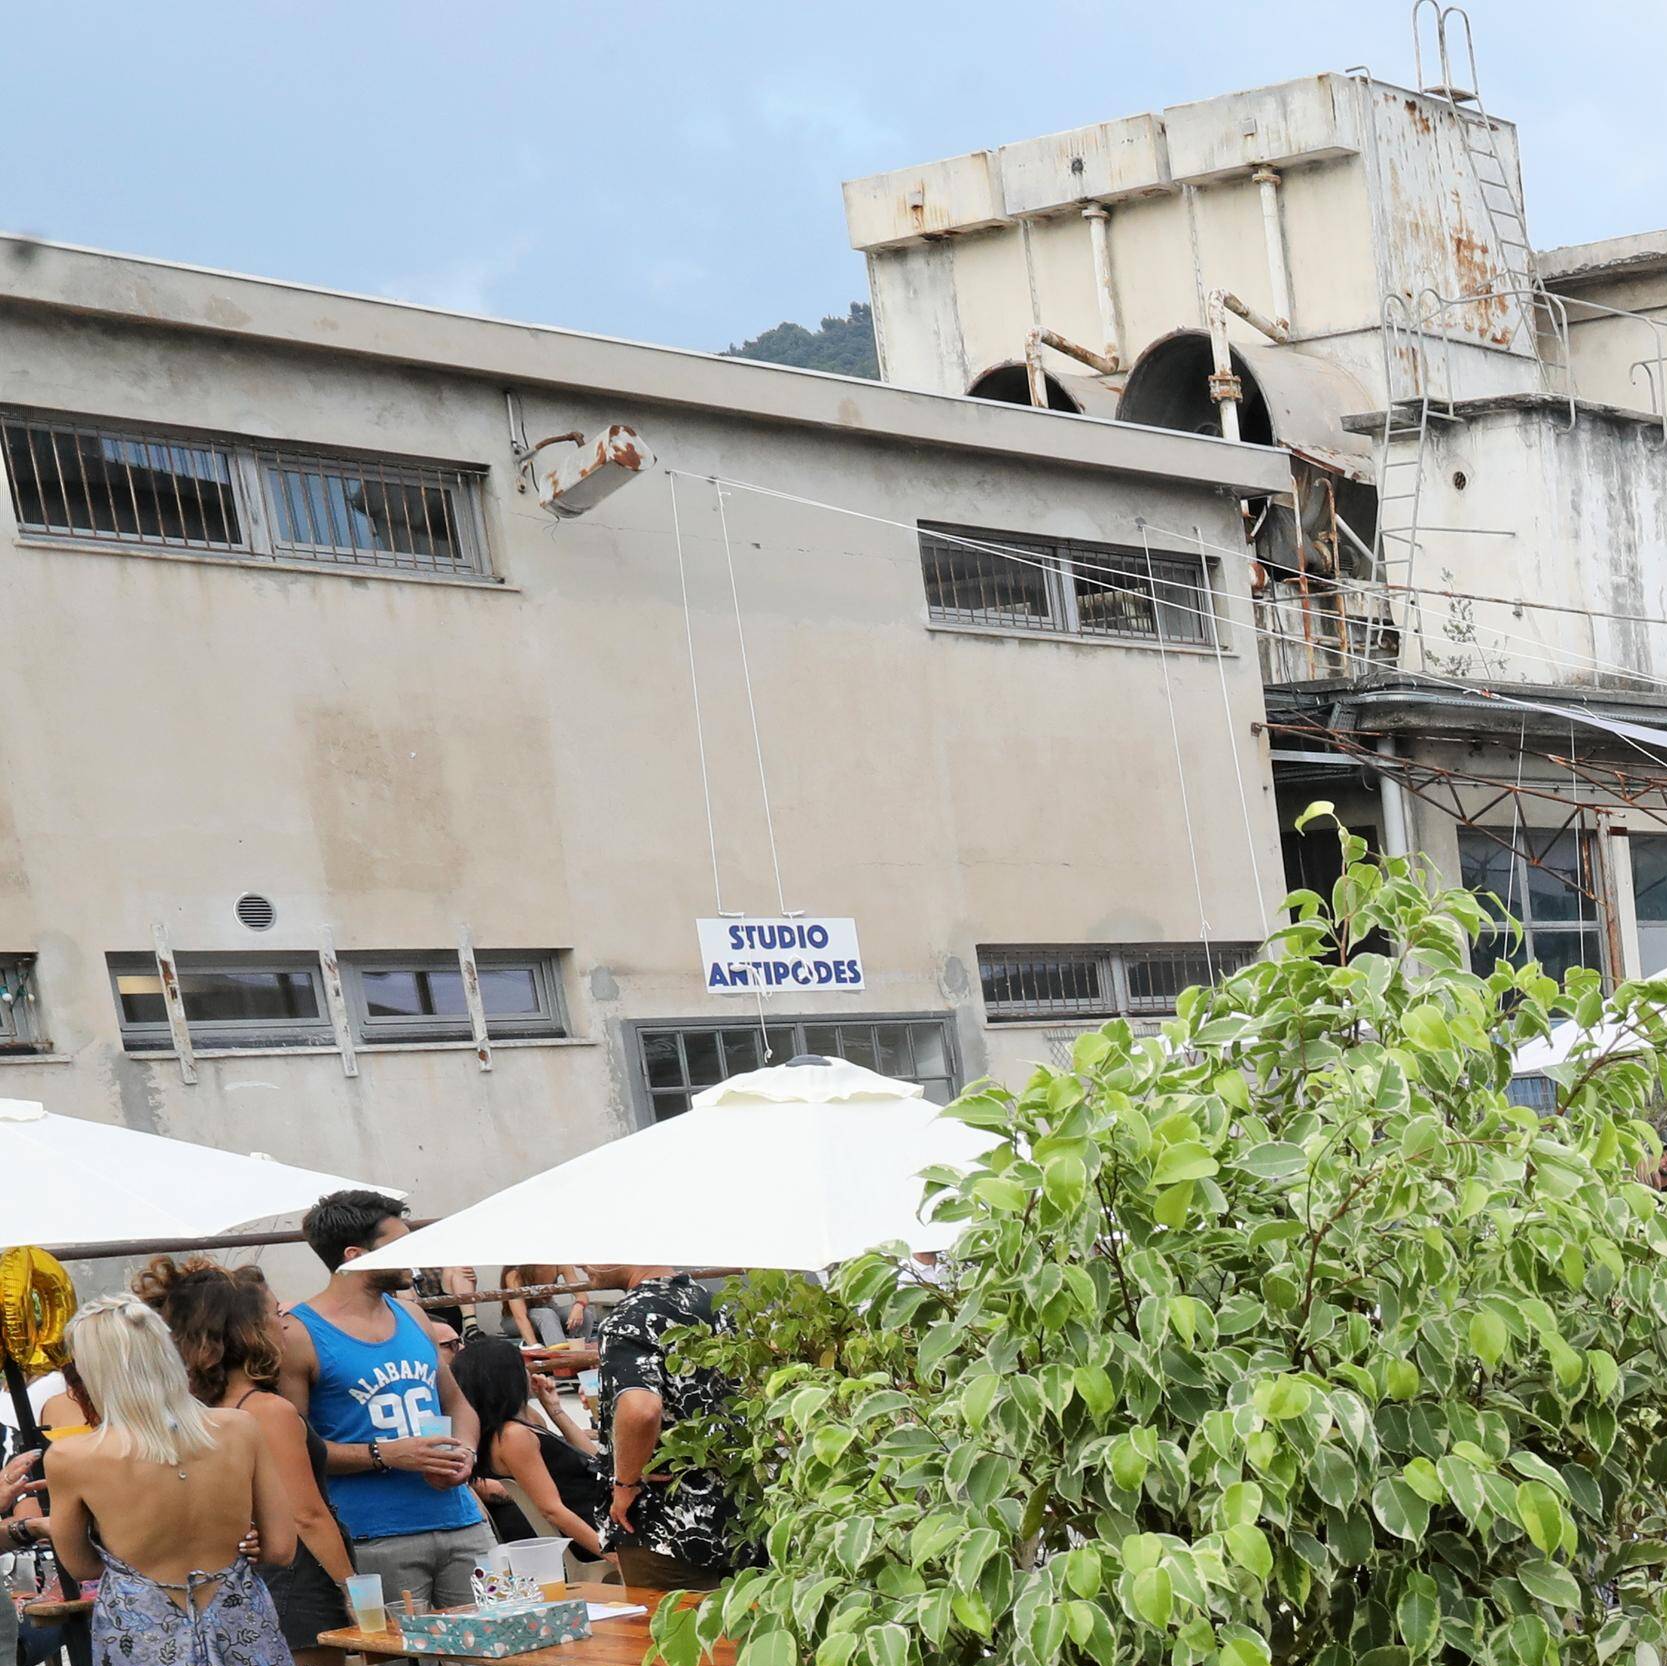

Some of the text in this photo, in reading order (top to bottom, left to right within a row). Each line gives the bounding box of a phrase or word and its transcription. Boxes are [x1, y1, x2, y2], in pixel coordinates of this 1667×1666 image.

[729, 924, 828, 950] STUDIO
[709, 959, 862, 987] ANTIPODES
[348, 1359, 437, 1405] ALABAMA
